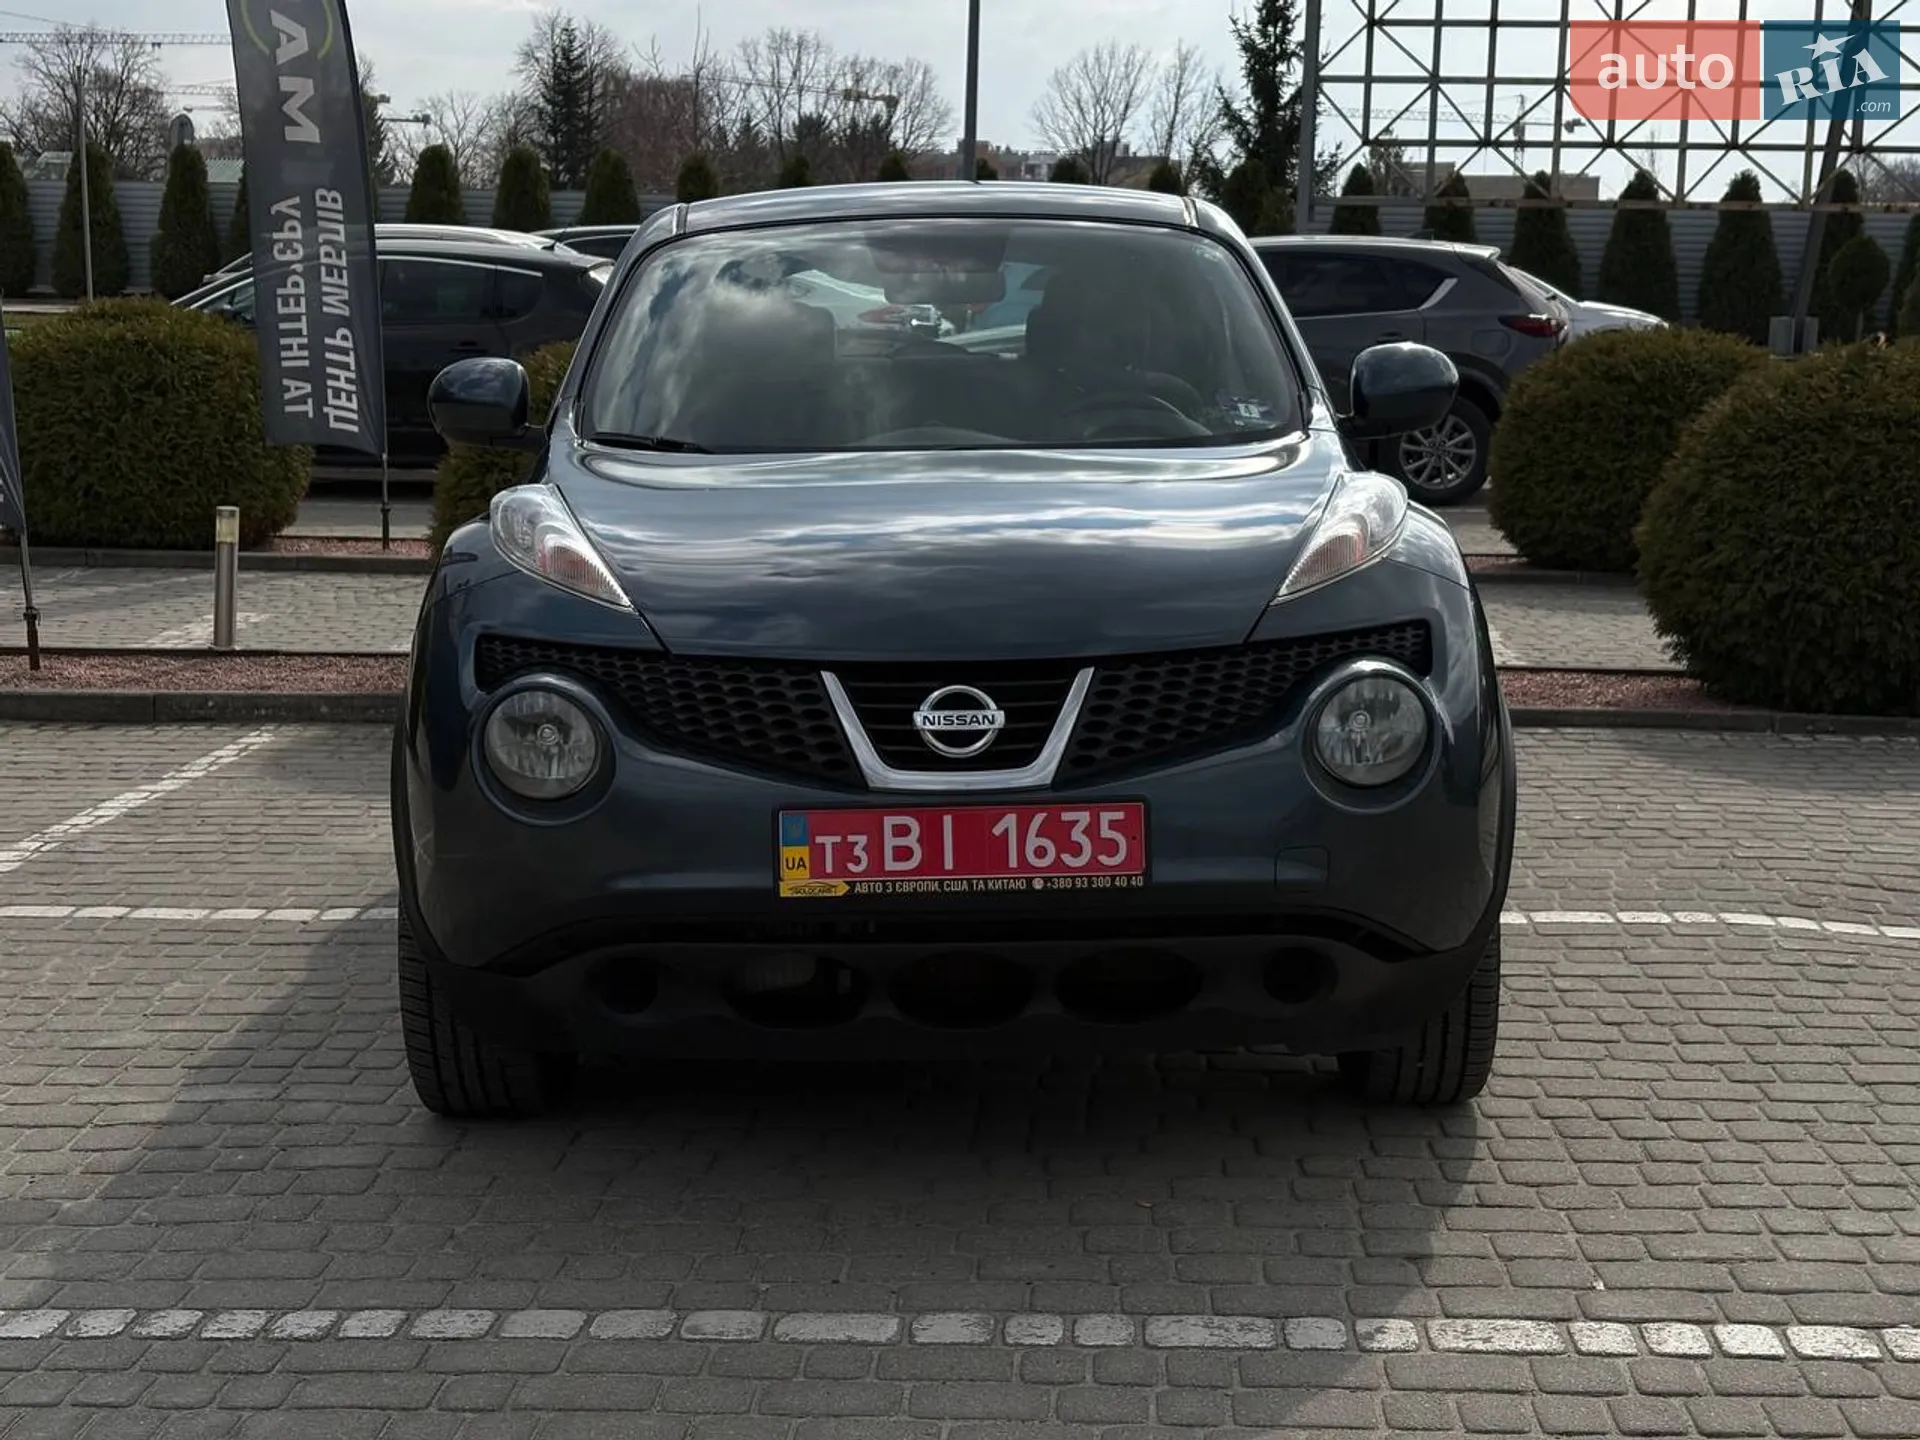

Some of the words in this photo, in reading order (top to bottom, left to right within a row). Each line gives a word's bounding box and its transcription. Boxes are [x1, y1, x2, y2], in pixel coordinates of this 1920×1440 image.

[922, 714, 996, 726] NISSAN
[991, 810, 1128, 869] 1635
[785, 856, 807, 871] UA
[854, 882, 884, 894] АВТО
[943, 879, 969, 892] США
[972, 879, 986, 891] ТА
[987, 878, 1028, 890] КИТАЮ
[1075, 876, 1089, 888] 93
[1091, 876, 1112, 888] 300
[1114, 876, 1128, 888] 40
[1129, 876, 1144, 888] 40
